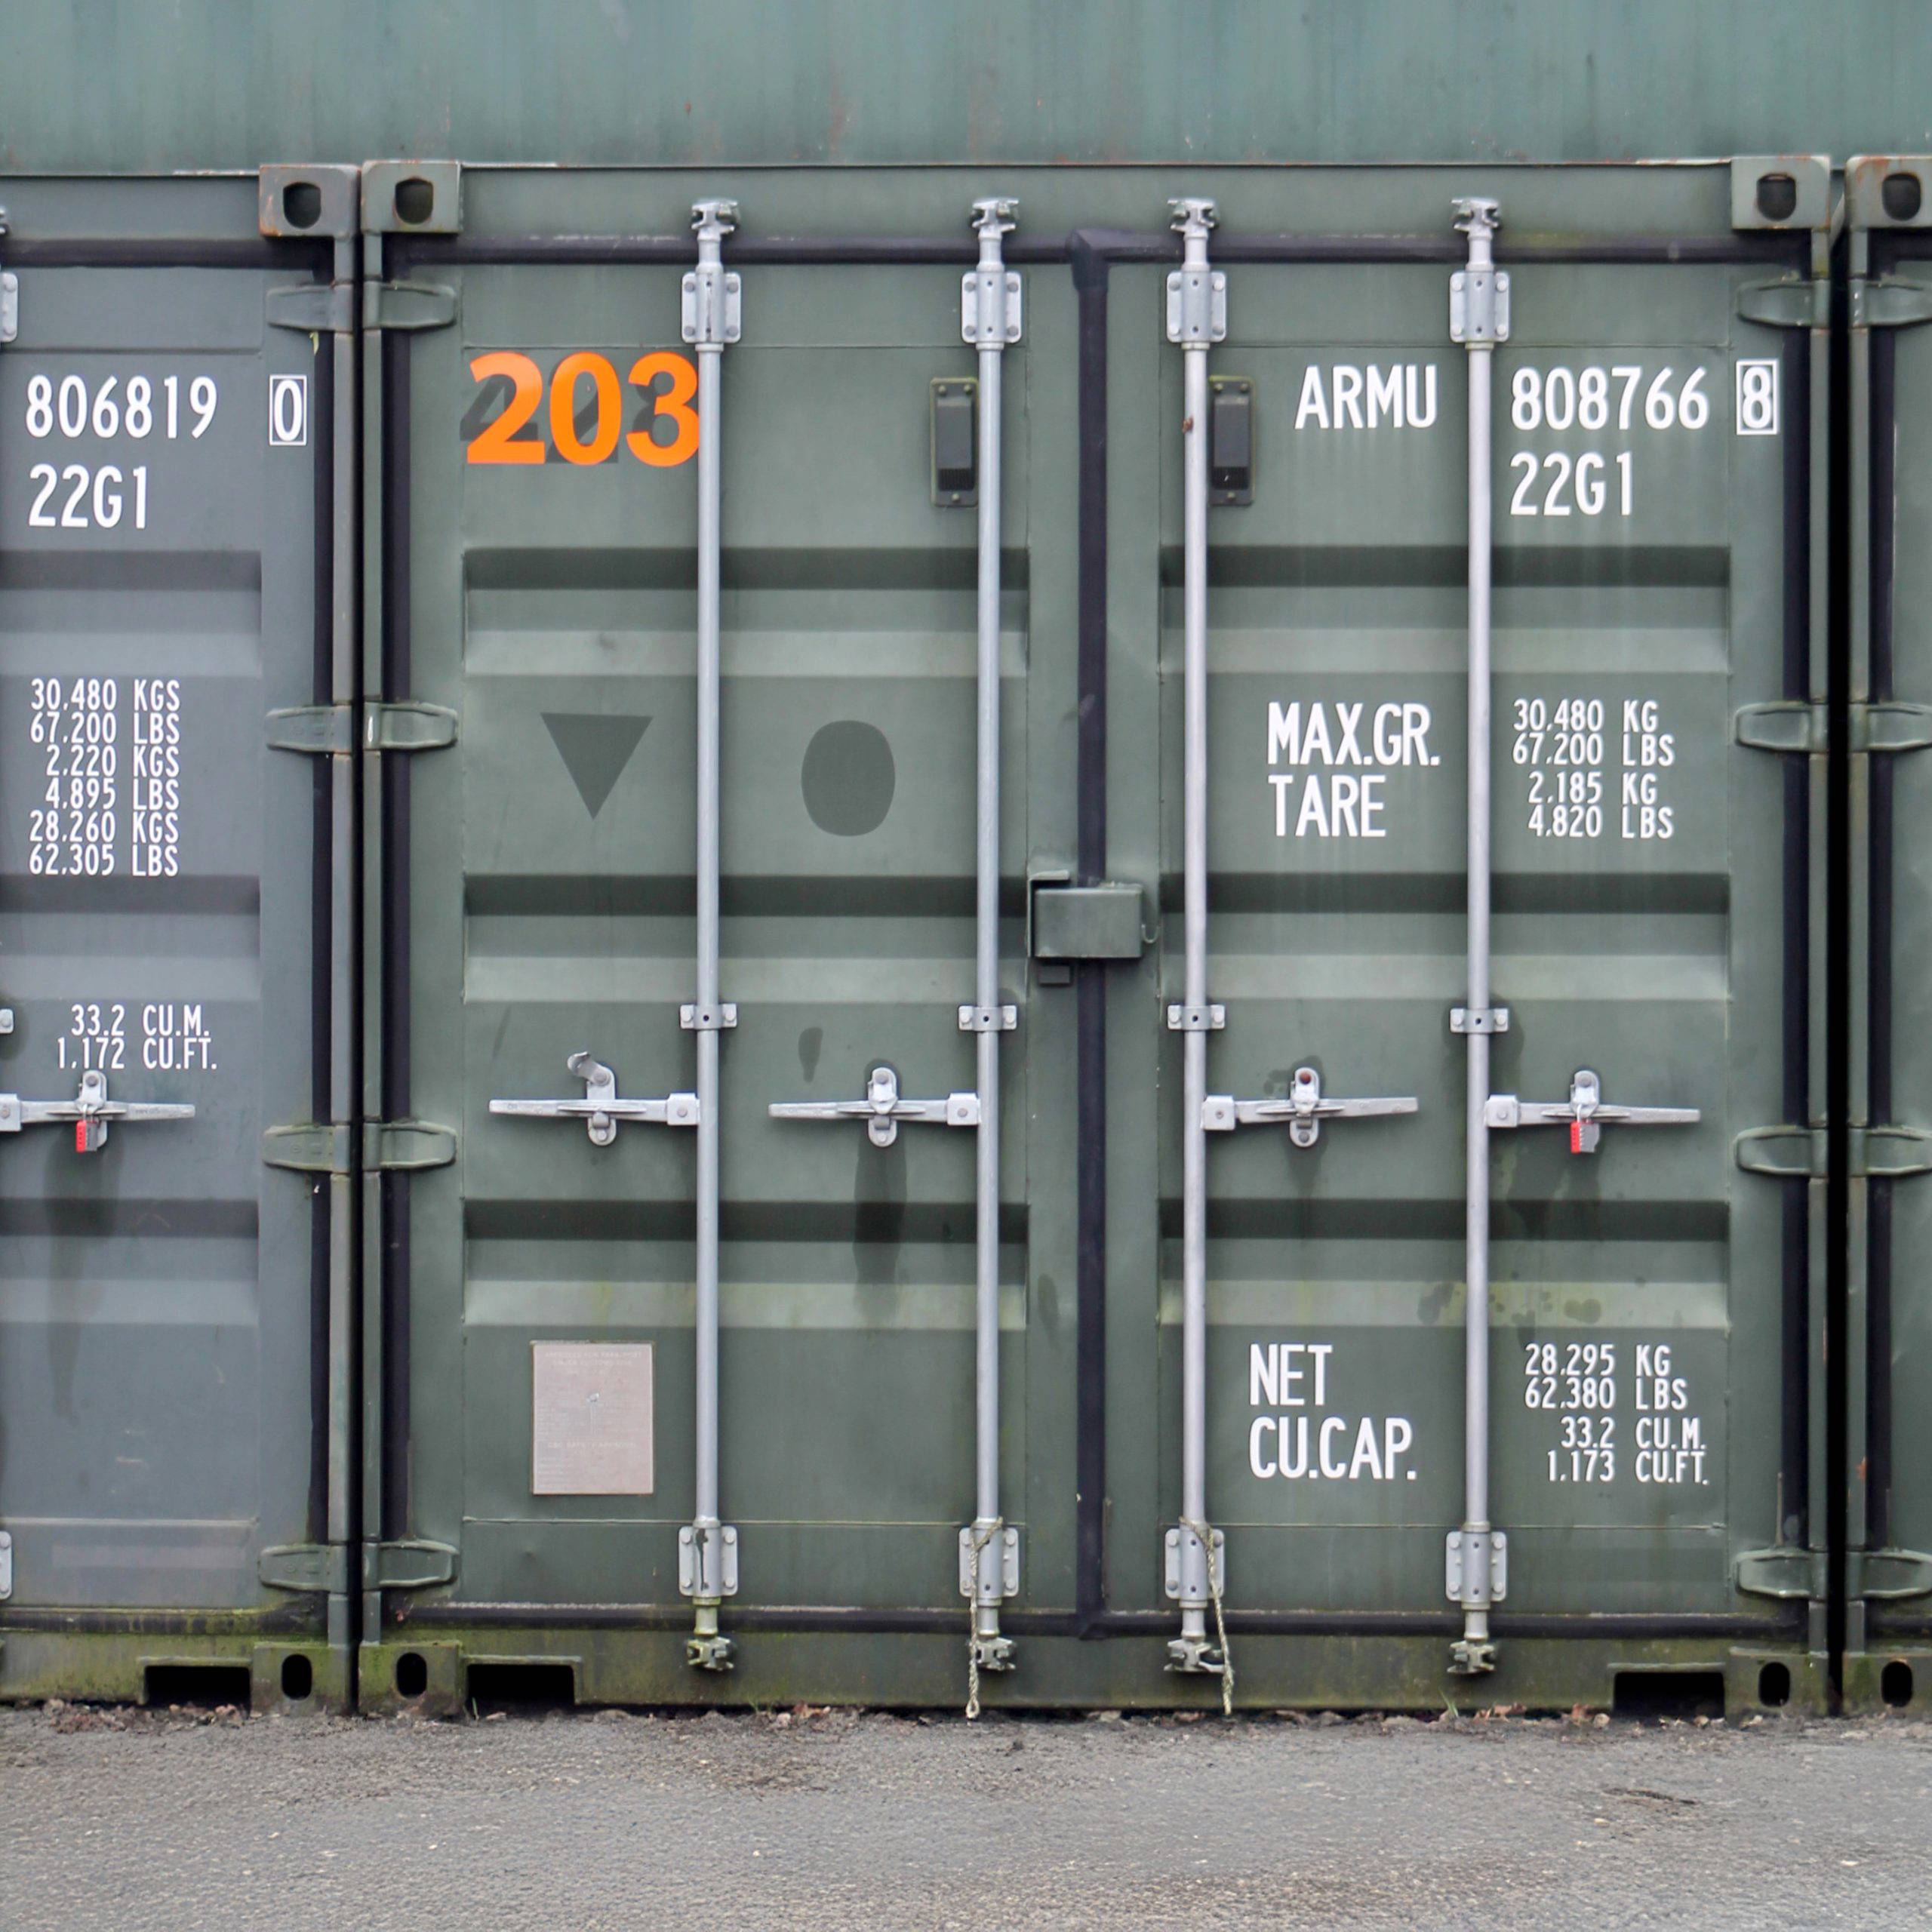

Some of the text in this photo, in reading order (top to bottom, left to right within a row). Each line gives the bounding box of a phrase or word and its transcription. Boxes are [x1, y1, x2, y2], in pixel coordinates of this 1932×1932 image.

[26, 374, 303, 442] 806819 0
[466, 351, 700, 467] 203
[1294, 364, 1773, 431] ARMU 808766 8
[28, 463, 147, 530] 22G1
[1510, 451, 1633, 516] 22G1
[134, 679, 180, 711] KGS
[134, 712, 180, 744] LBS
[1623, 700, 1659, 733] KG
[1267, 701, 1441, 767] MAX.GR.
[1623, 733, 1675, 767] LBS
[133, 746, 180, 777] KGS
[133, 778, 179, 811] LBS
[1622, 772, 1658, 805] KG
[1268, 774, 1387, 838] TARE
[1622, 806, 1675, 839] LBS
[132, 811, 179, 844] KGS
[131, 844, 178, 877] LBS
[71, 1004, 210, 1036] 33.2 CU.M.
[142, 1037, 217, 1069] CU.FT.
[1250, 1343, 1334, 1407] NET
[1635, 1344, 1672, 1377] KG
[1635, 1377, 1688, 1411] LBS
[1249, 1416, 1417, 1481] CU.CAP.
[1561, 1416, 1706, 1450] 33.2 CU.M.
[1635, 1451, 1709, 1485] CU.FT.
